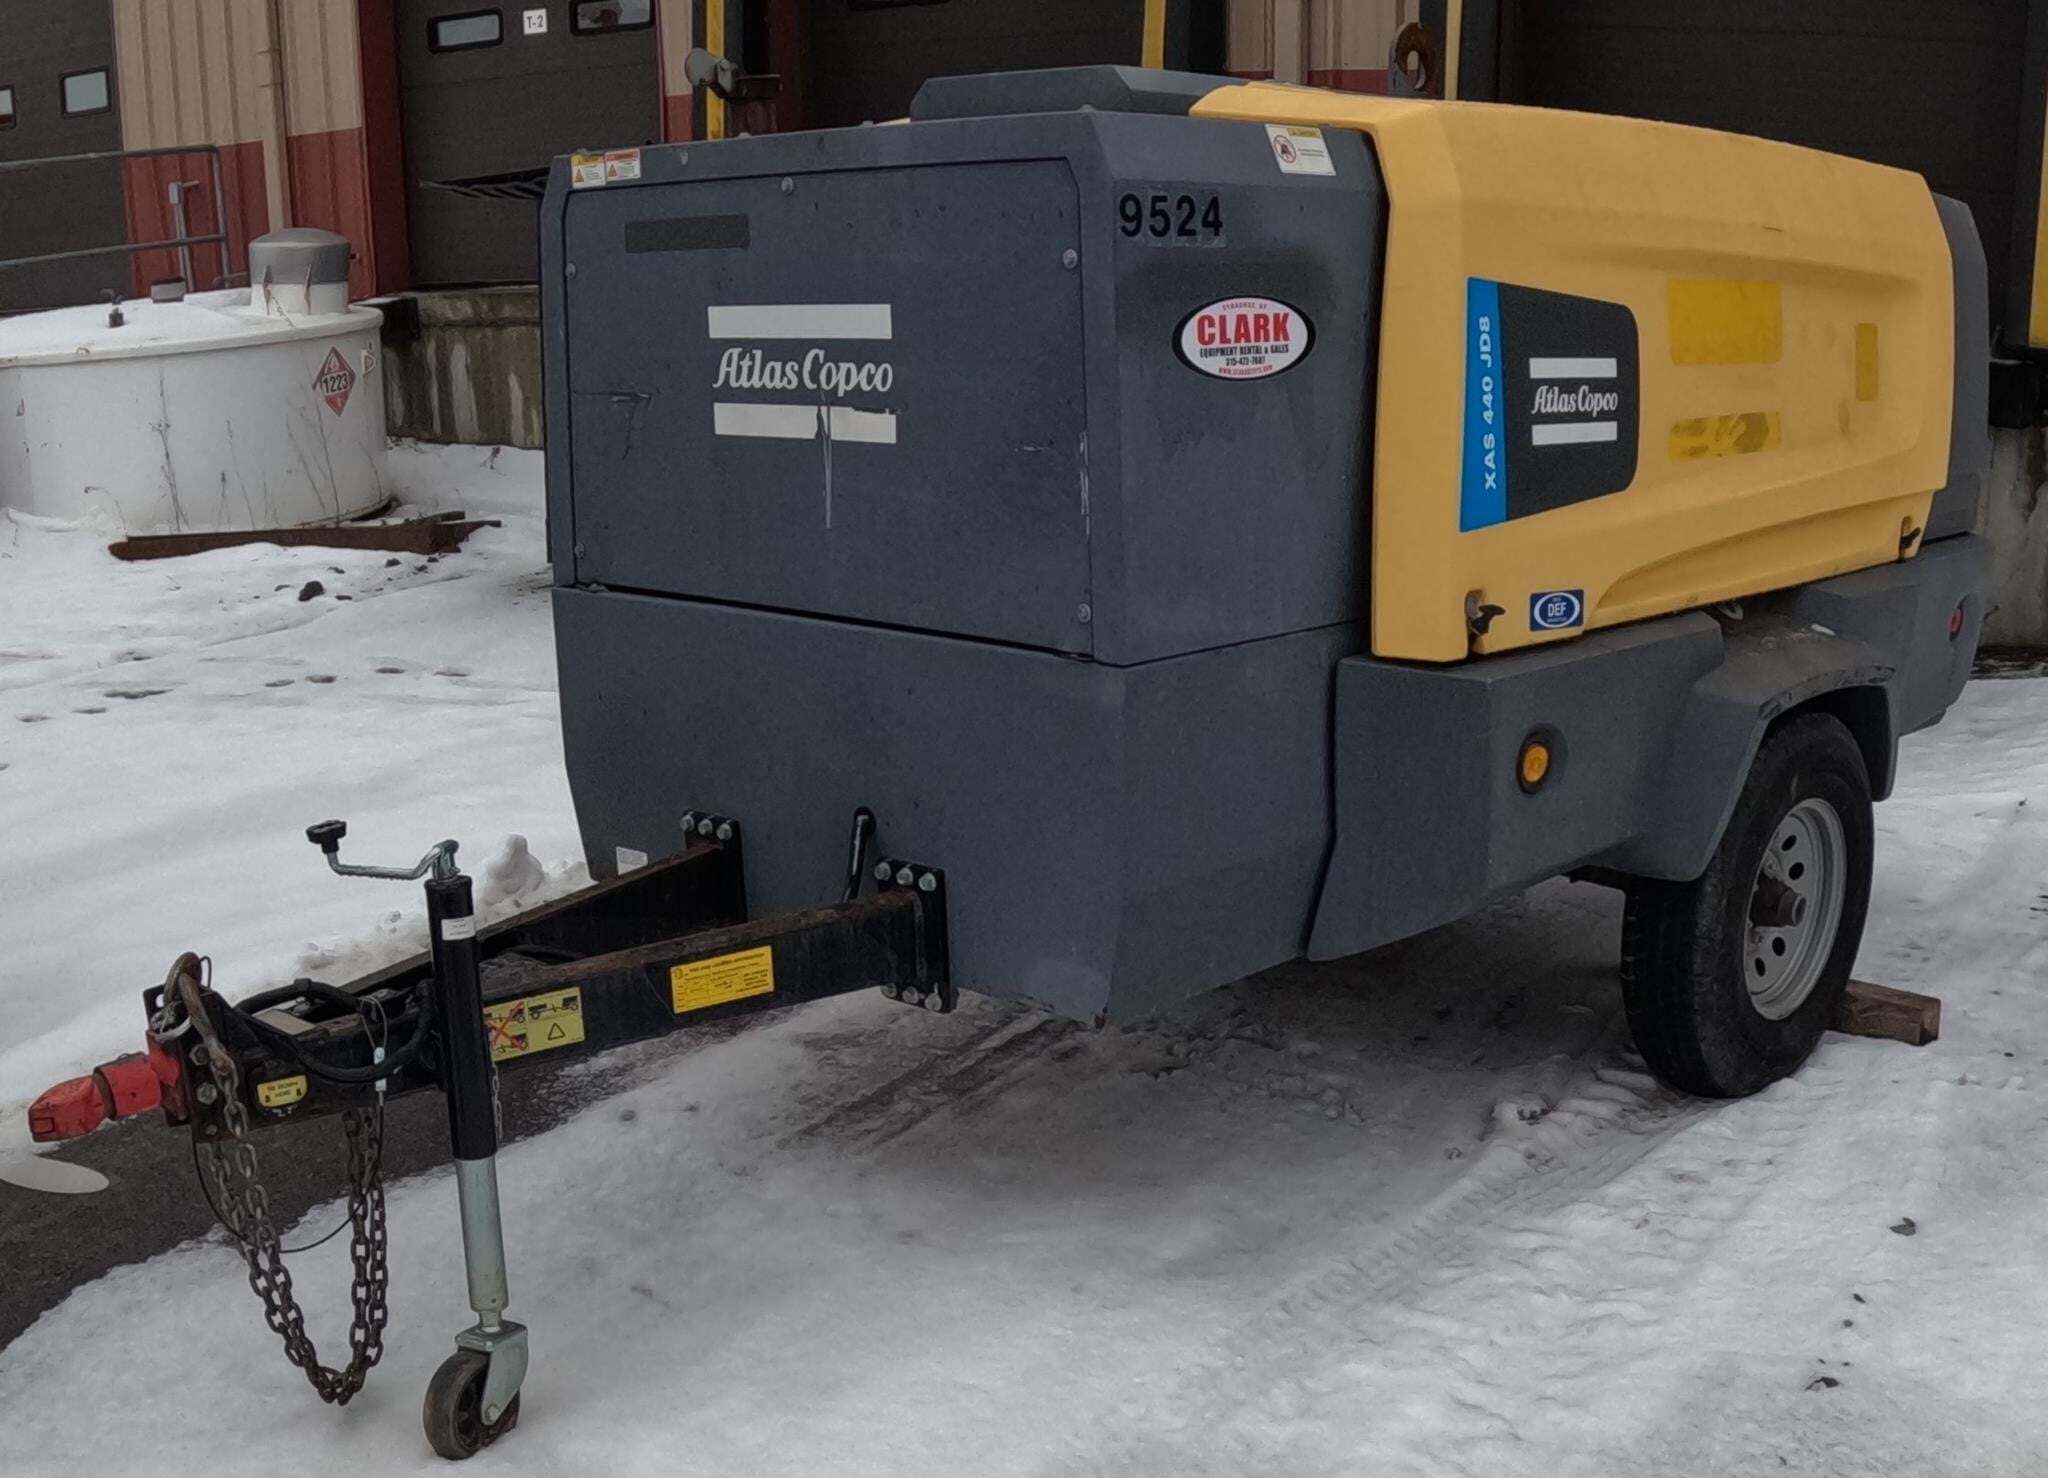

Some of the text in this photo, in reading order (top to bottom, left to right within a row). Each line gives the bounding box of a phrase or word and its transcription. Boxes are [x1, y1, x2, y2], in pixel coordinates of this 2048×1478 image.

[526, 14, 544, 29] T-2
[1119, 193, 1224, 238] 9524
[1197, 312, 1290, 346] CLARK
[1200, 347, 1238, 359] EQUIPMENT
[1239, 346, 1262, 356] RENTAL
[1270, 344, 1289, 354] SALES
[323, 373, 348, 393] 1223
[712, 347, 893, 397] Atlas Copco
[1479, 316, 1497, 489] XAS 440 JD8
[1531, 384, 1618, 418] Atlas Copco
[1547, 602, 1567, 617] DEF
